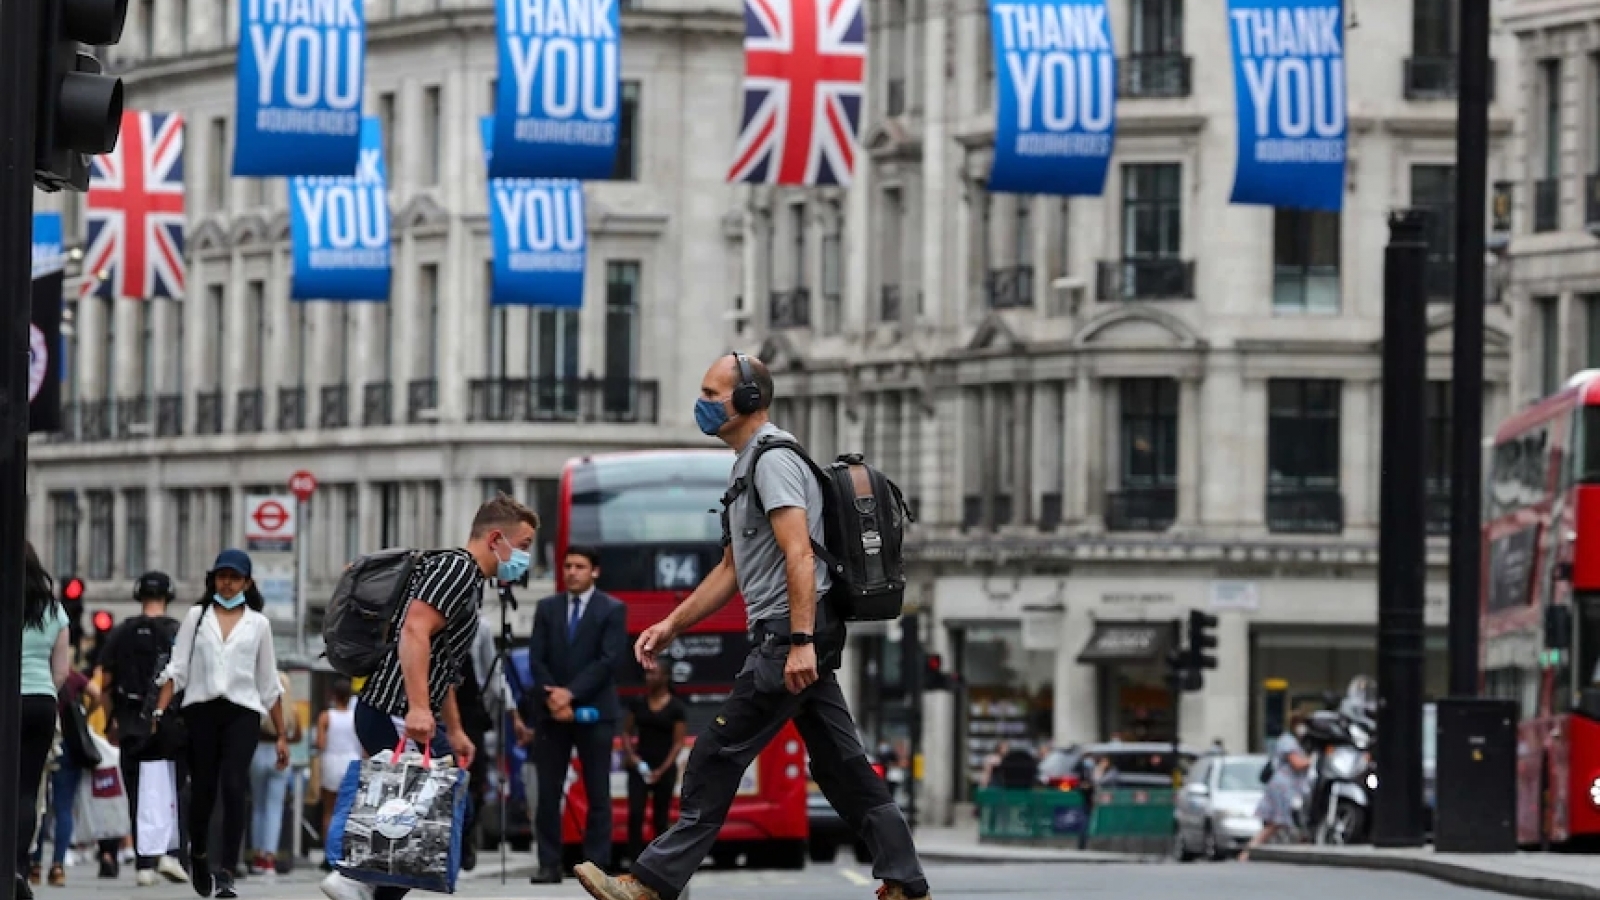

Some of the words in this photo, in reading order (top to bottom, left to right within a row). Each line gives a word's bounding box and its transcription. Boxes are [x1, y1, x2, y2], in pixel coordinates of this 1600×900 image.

[505, 0, 616, 38] THANK
[993, 3, 1111, 50] THANK
[1230, 7, 1342, 56] THANK
[250, 23, 361, 108] YOU
[507, 35, 617, 119] YOU
[1005, 50, 1113, 132] YOU
[1241, 57, 1344, 137] YOU
[297, 186, 388, 248] YOU
[496, 188, 583, 251] YOU
[658, 556, 694, 587] 94
